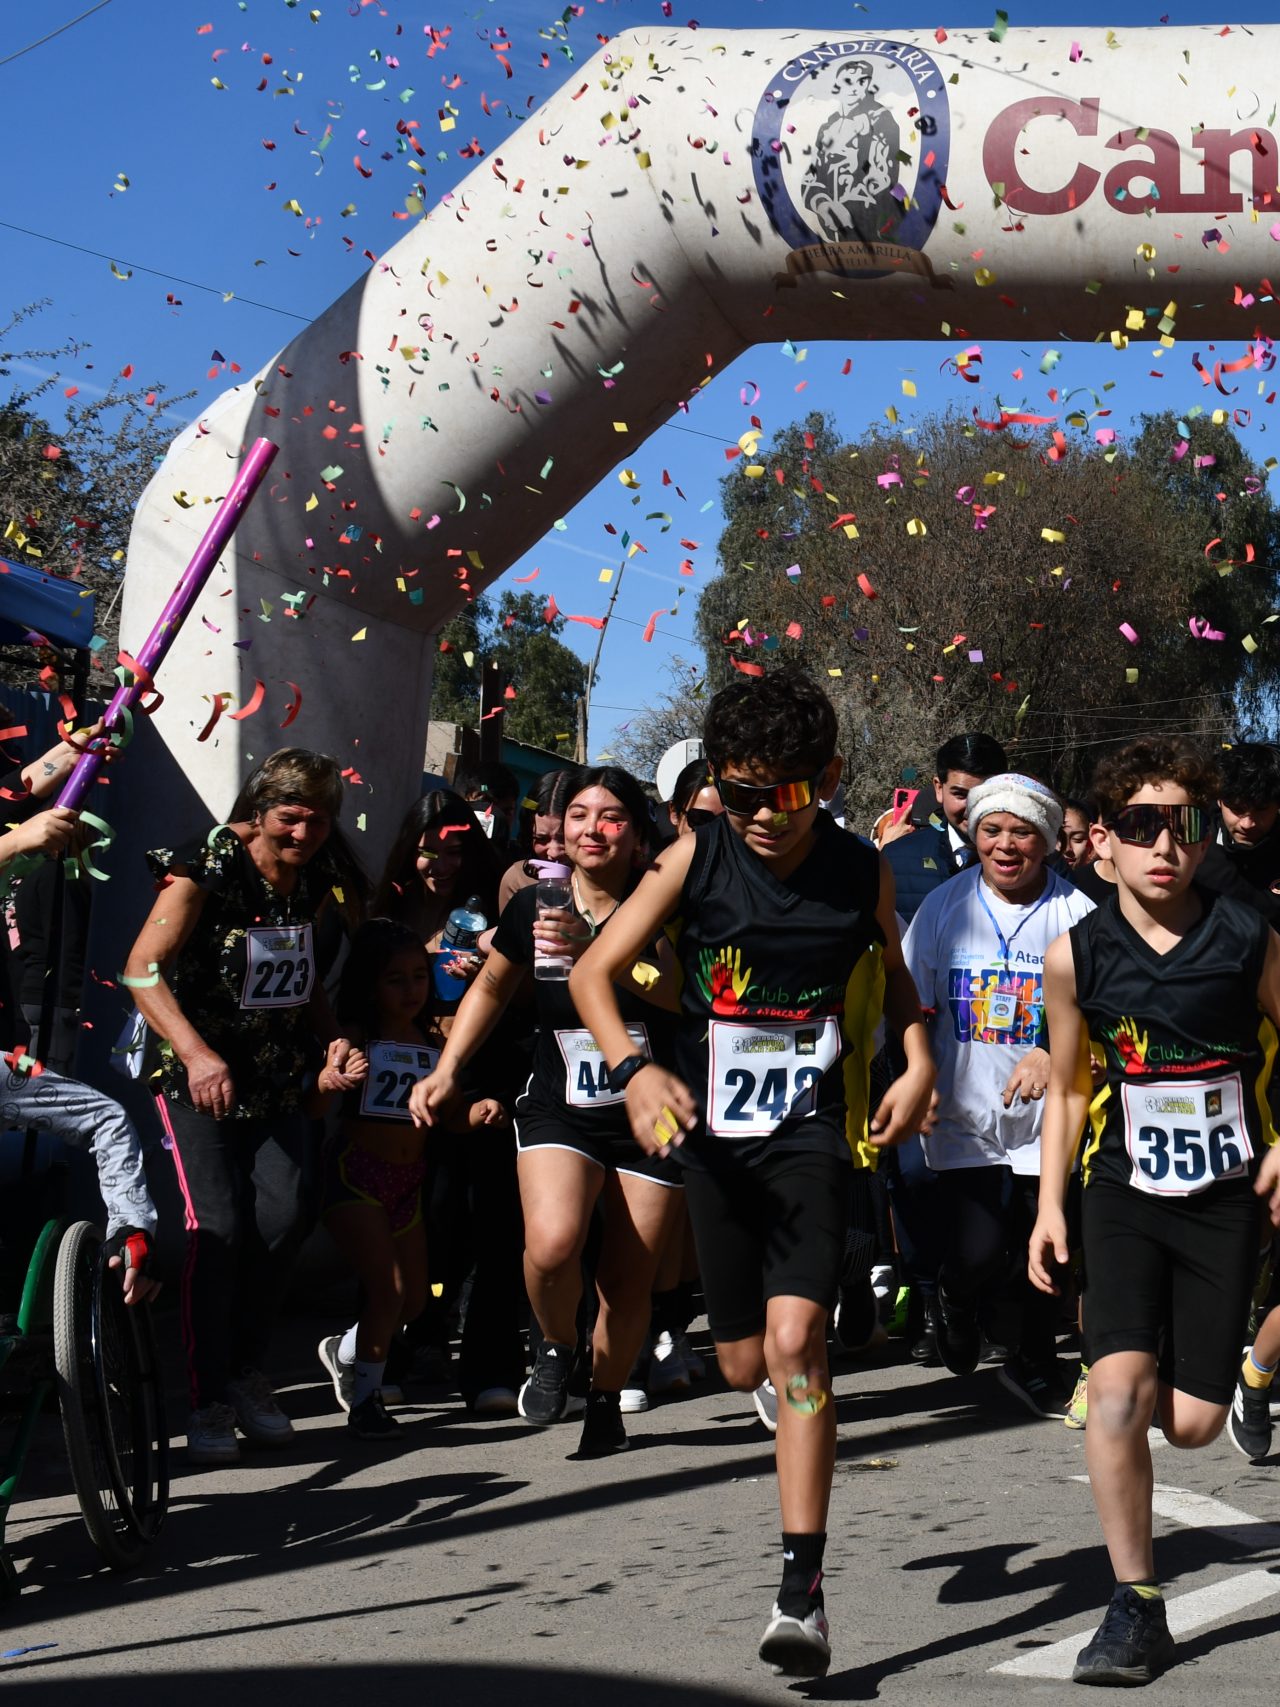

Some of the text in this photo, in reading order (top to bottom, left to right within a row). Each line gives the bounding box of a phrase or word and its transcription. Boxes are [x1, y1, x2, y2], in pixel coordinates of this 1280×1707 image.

[782, 40, 936, 85] CANDELARIA
[252, 957, 309, 998] 223
[746, 985, 790, 1003] Club
[1148, 1044, 1184, 1060] Club
[372, 1069, 428, 1109] 22
[1138, 1123, 1242, 1181] 356
